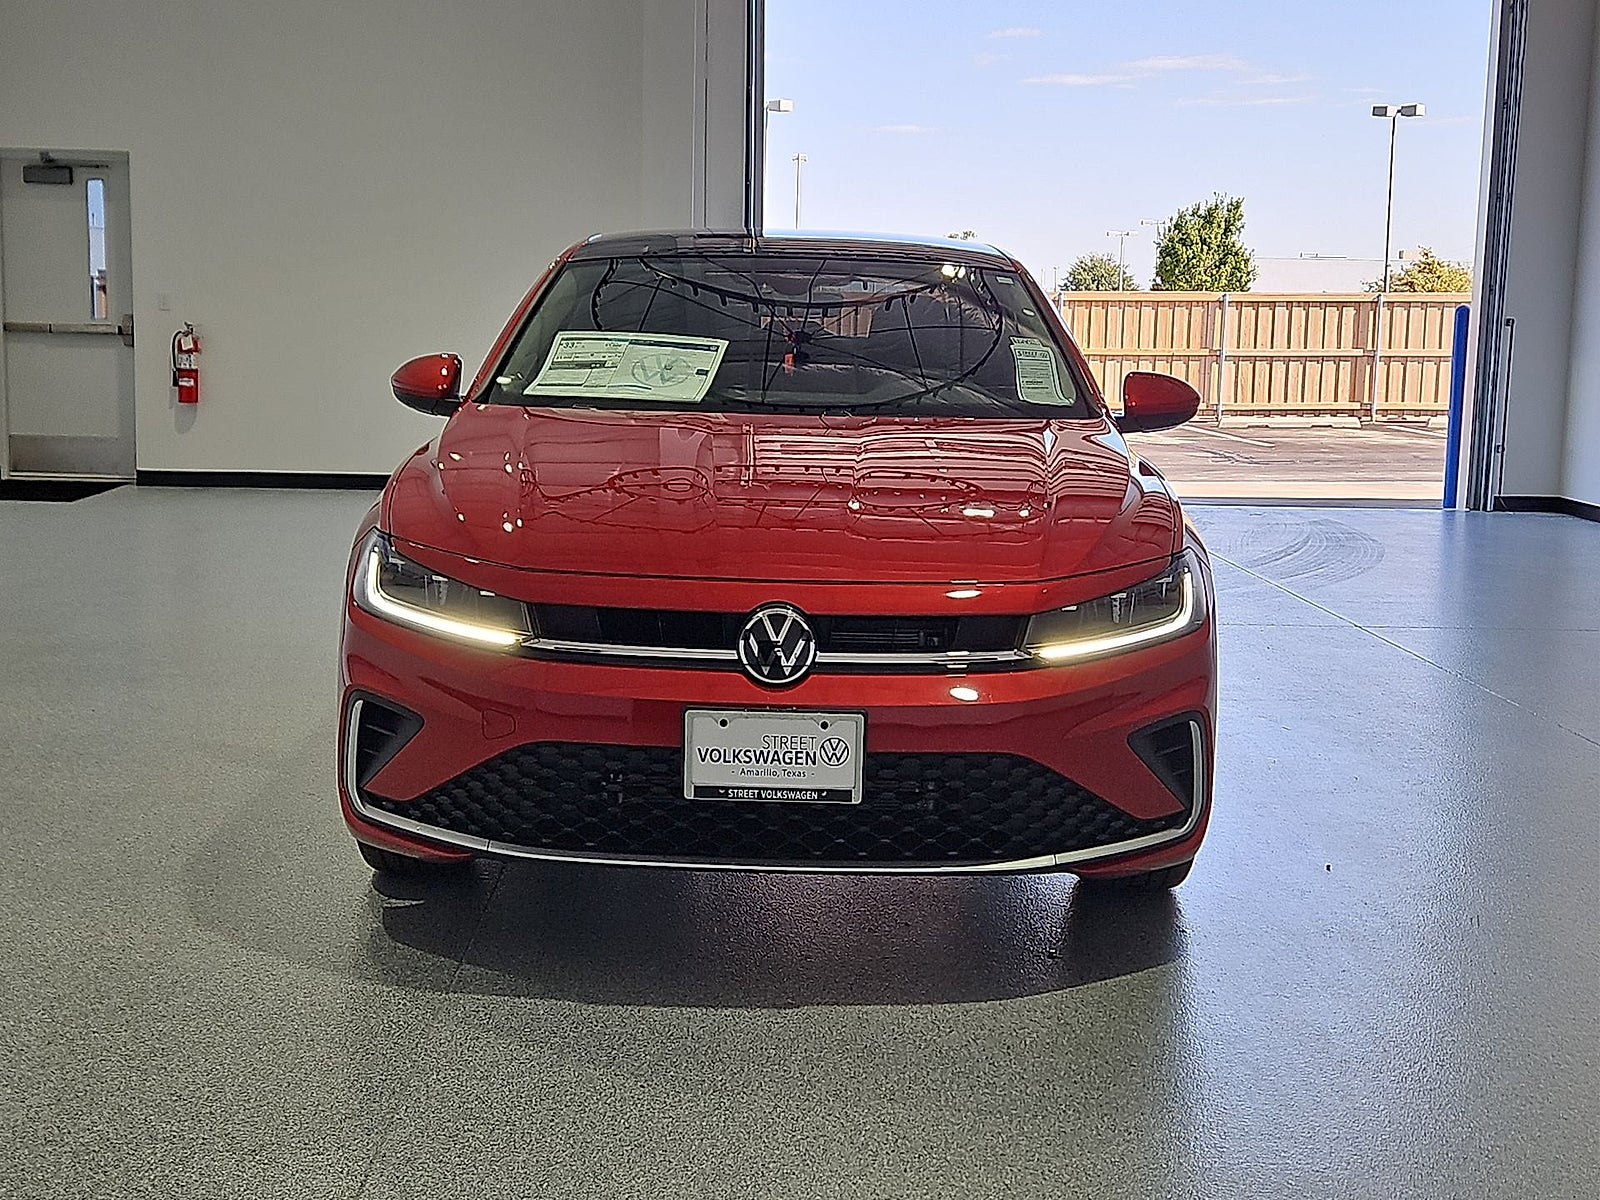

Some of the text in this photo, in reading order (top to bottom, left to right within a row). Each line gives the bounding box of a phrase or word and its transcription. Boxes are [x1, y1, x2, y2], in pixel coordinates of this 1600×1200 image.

[762, 735, 817, 750] STREET
[697, 748, 817, 765] VOLKSWAGEN
[739, 768, 806, 778] Amarillo, Texas
[728, 789, 818, 800] STREET VOLKSWAGEN
